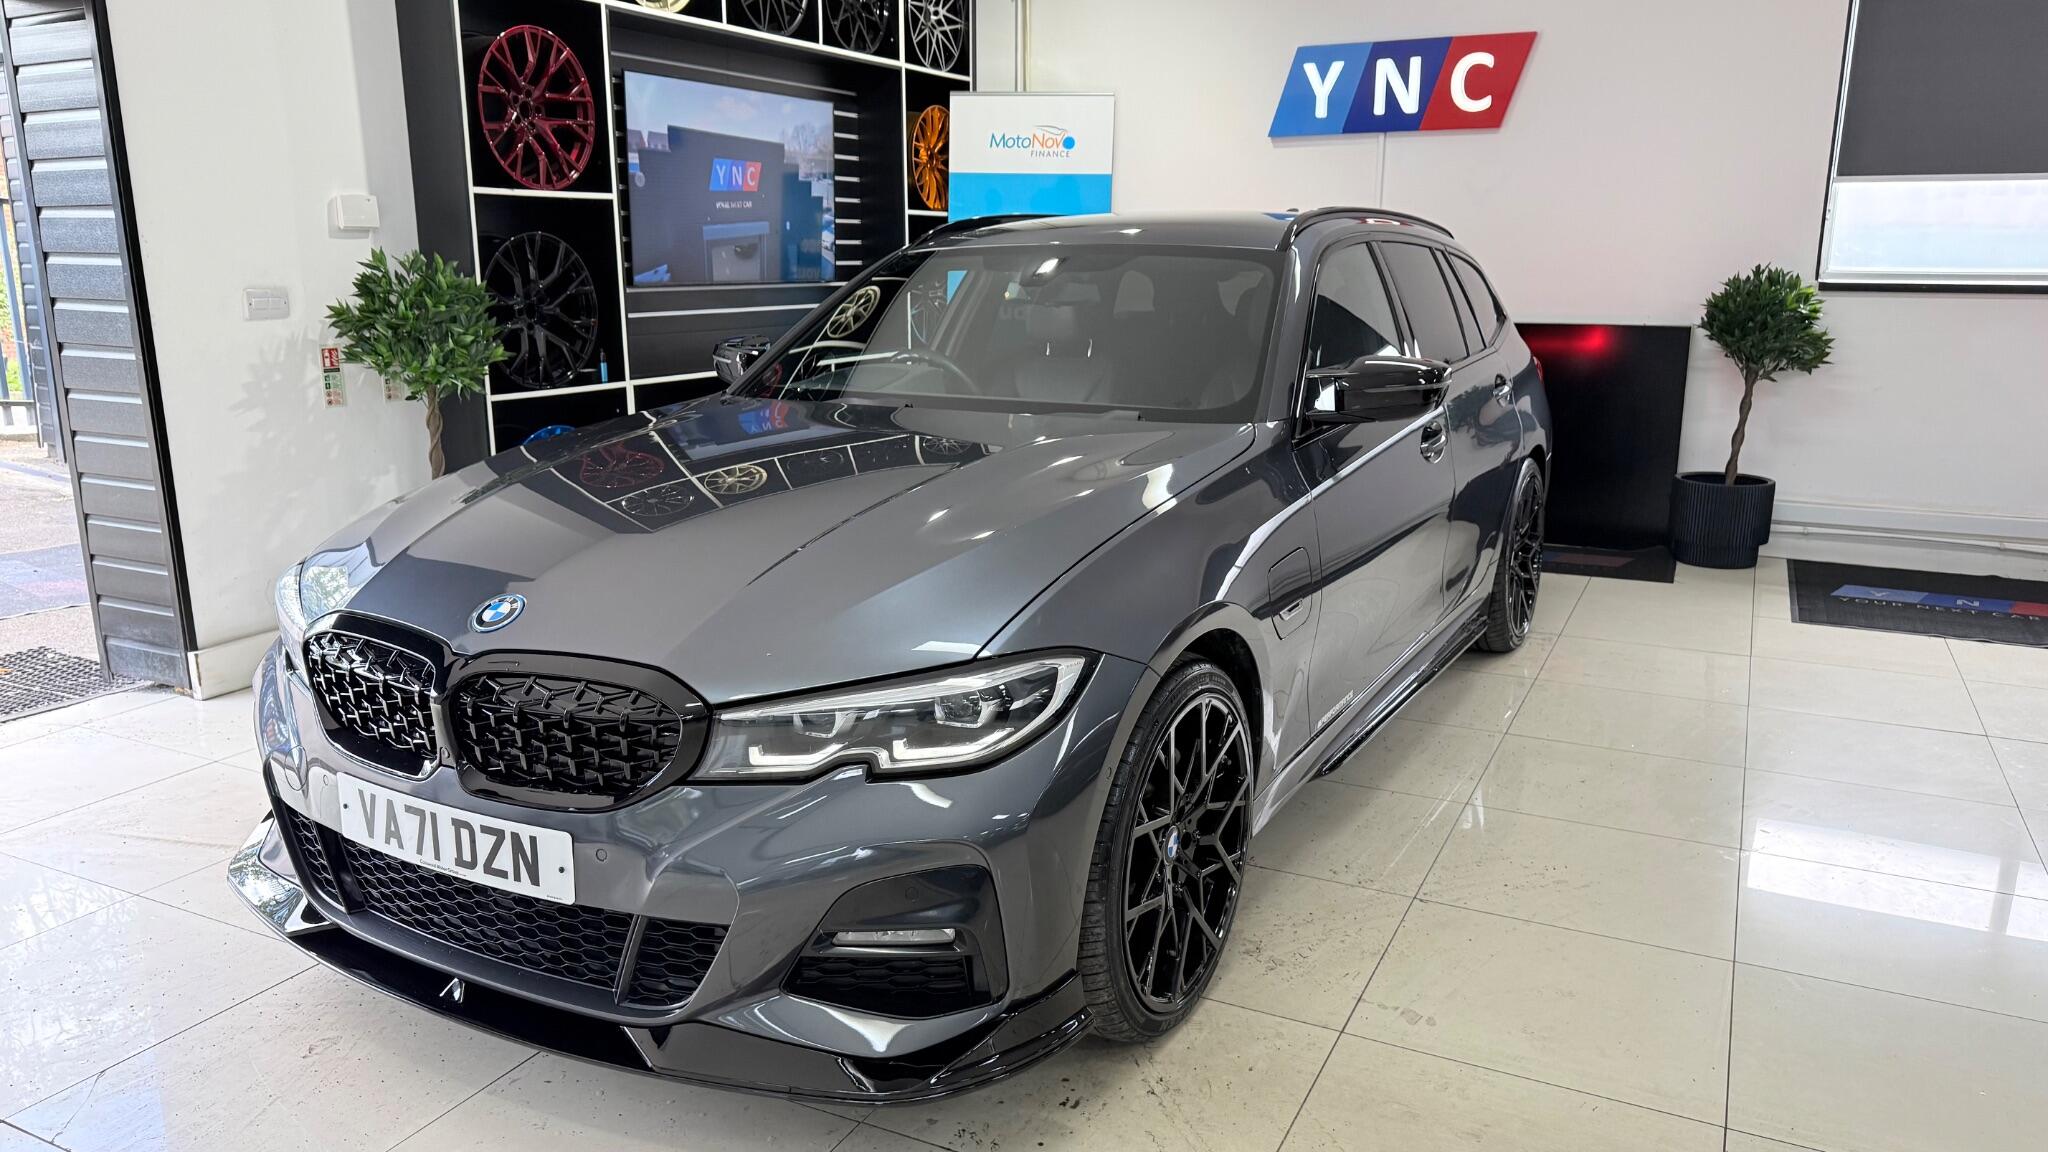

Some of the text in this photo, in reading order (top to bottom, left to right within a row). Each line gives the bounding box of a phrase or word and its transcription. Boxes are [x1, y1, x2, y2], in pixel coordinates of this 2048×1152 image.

[1303, 51, 1494, 118] YNC
[989, 131, 1075, 150] MotoNovo
[1030, 150, 1070, 158] FINANCE
[716, 165, 756, 186] YNC
[358, 788, 541, 887] VA71 DZN
